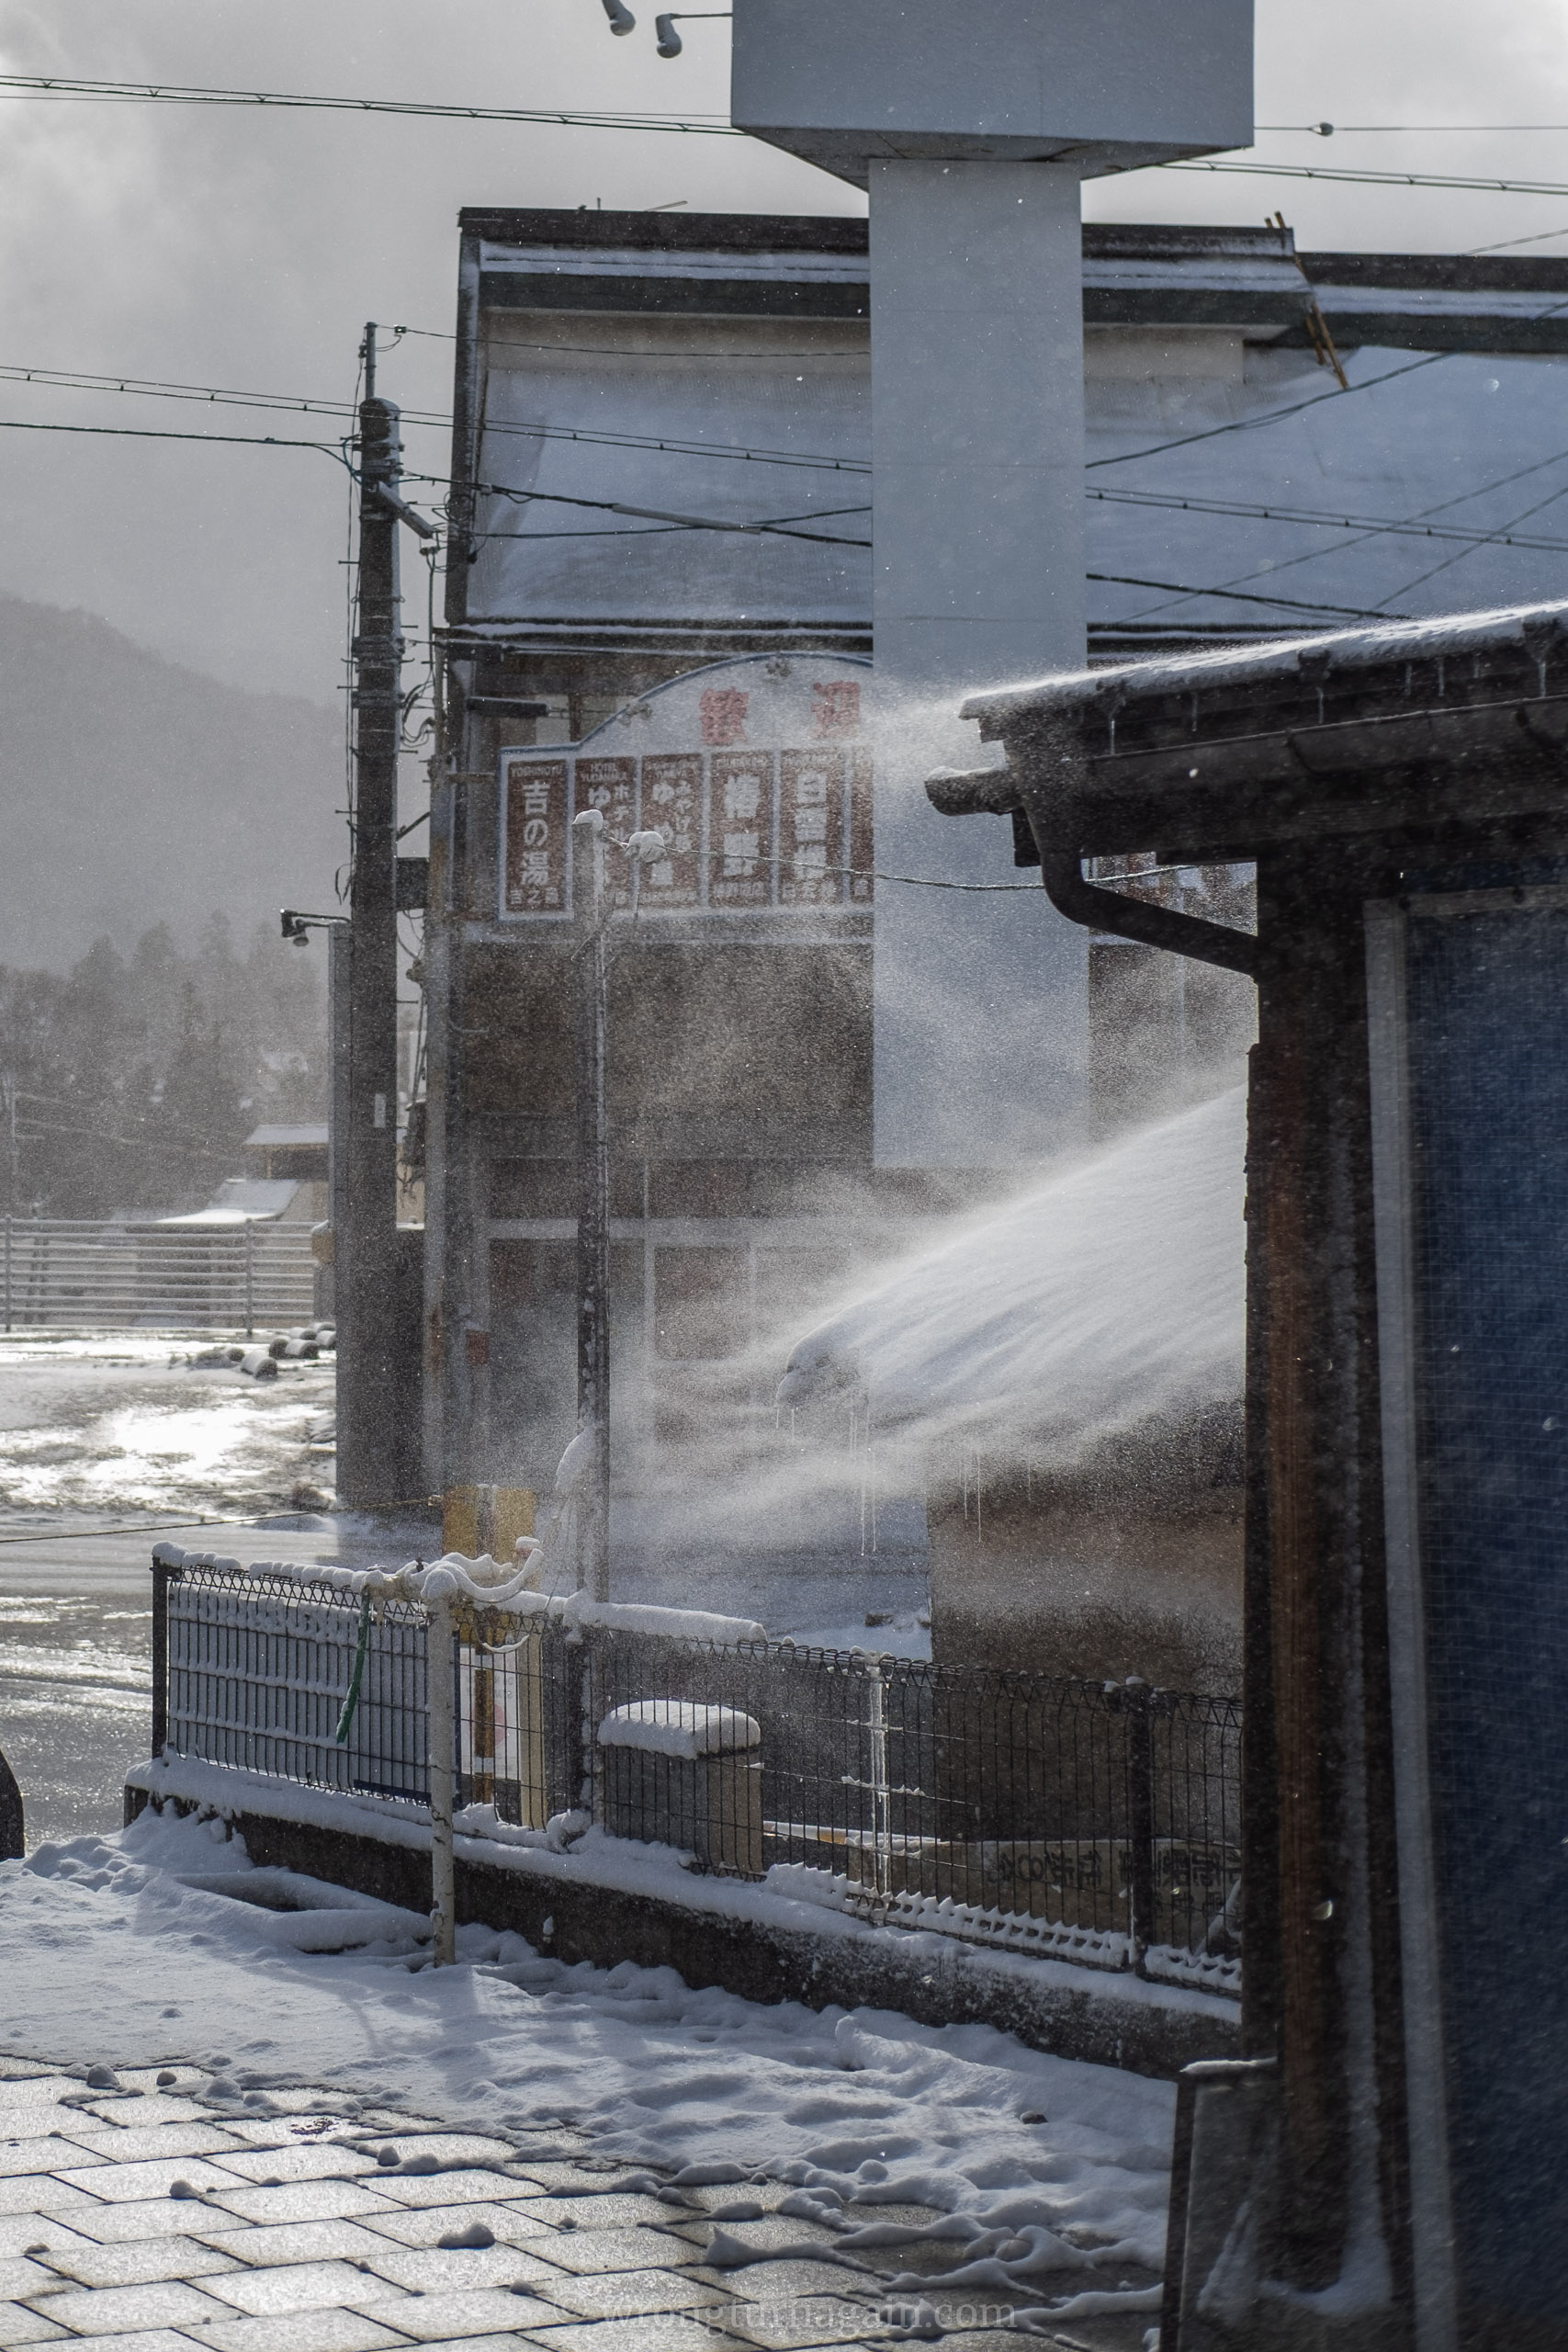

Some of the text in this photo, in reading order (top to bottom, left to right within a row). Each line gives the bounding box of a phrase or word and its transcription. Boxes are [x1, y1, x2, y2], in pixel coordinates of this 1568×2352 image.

[511, 765, 563, 777] YOSHINOYU
[591, 763, 616, 772] HOTEL
[581, 772, 628, 781] YUDANAKA
[613, 783, 630, 842] ホテル
[520, 780, 549, 888] 吉の湯
